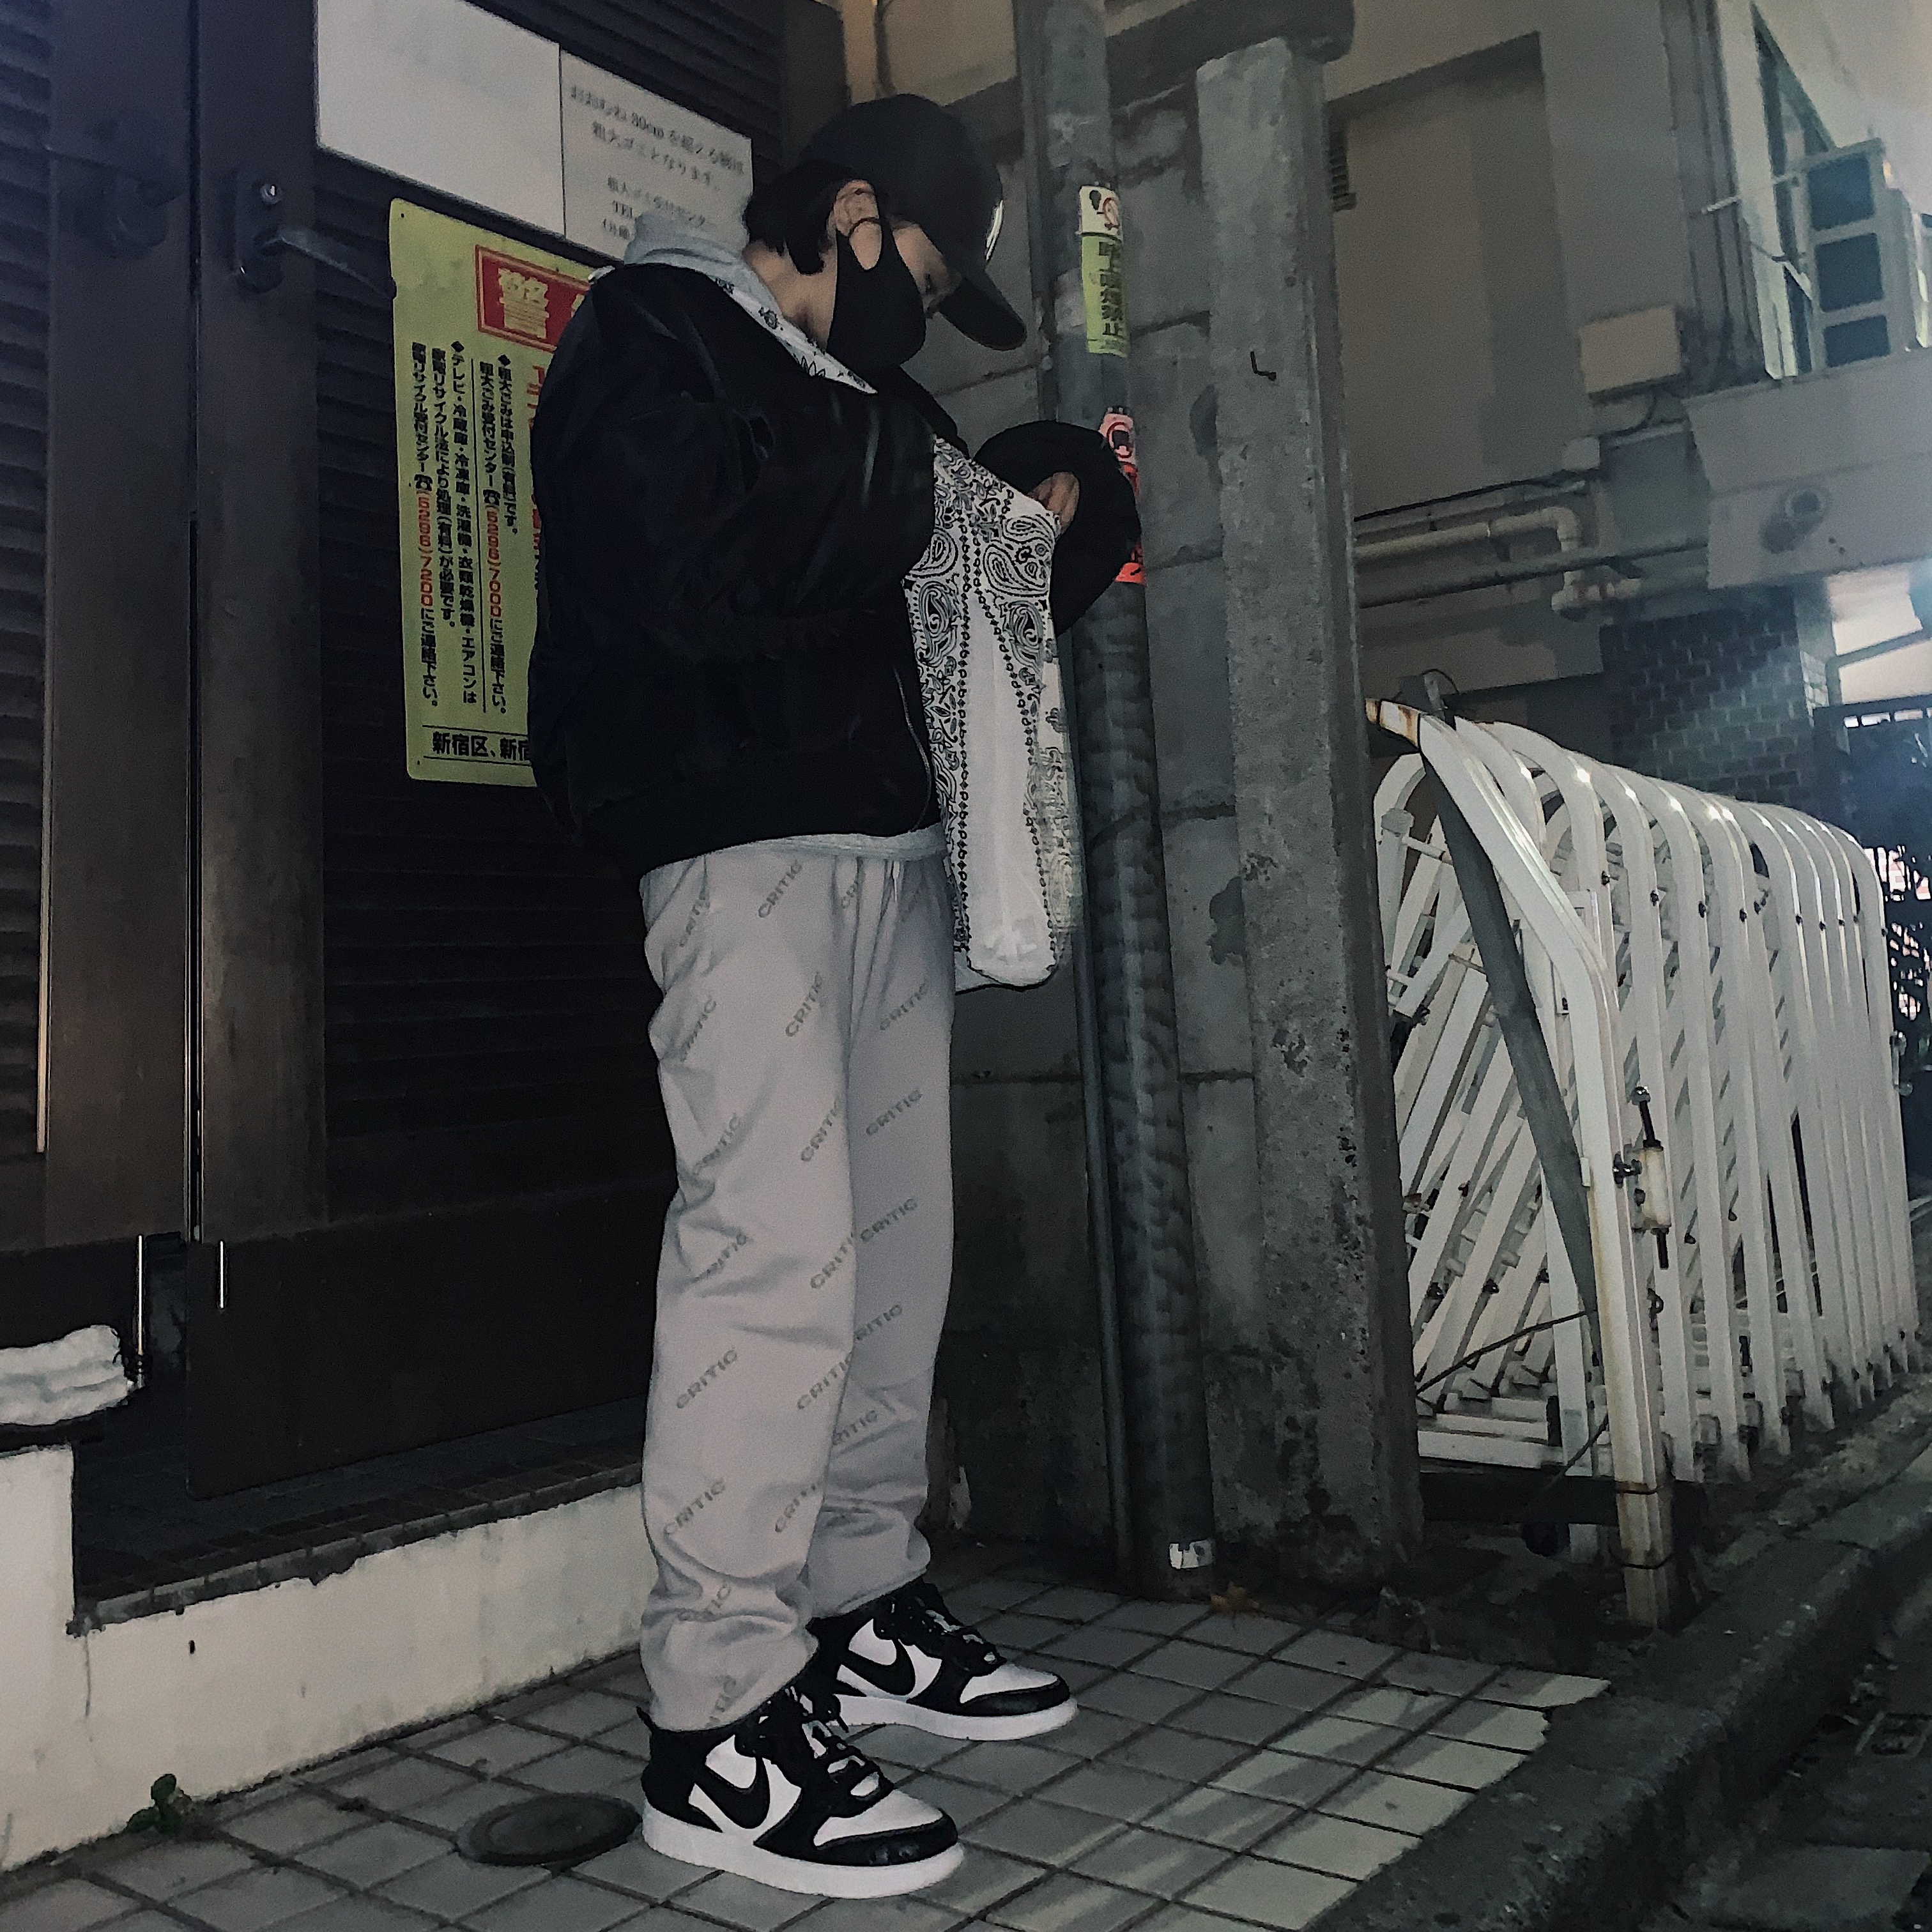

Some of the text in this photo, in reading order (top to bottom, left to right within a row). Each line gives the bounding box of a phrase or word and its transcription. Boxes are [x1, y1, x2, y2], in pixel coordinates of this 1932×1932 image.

[758, 859, 803, 919] CRITIC
[866, 1089, 923, 1136] CRITIC
[861, 1197, 918, 1242] CRITIC
[855, 1304, 903, 1341] RITIC
[676, 1347, 738, 1409] CRITIC
[832, 1409, 878, 1446] RITIC
[663, 1478, 726, 1537] CRITIC
